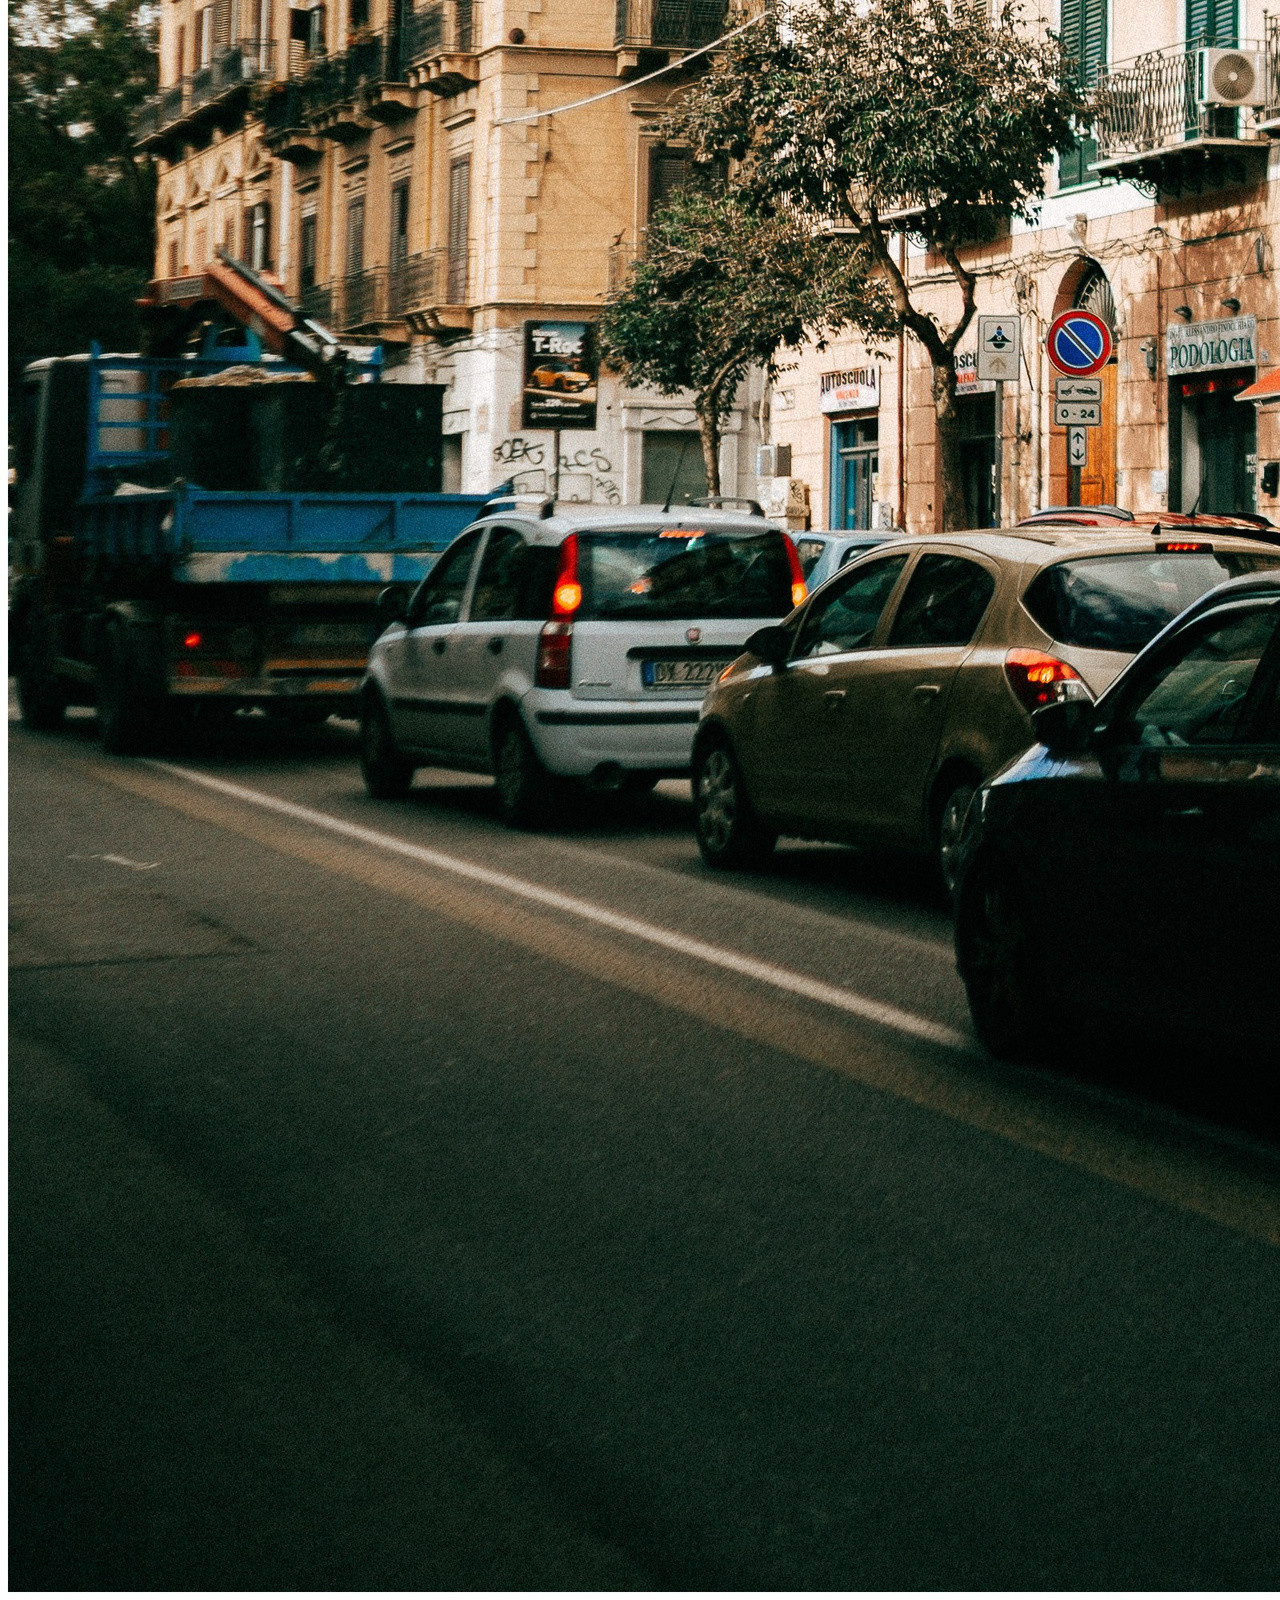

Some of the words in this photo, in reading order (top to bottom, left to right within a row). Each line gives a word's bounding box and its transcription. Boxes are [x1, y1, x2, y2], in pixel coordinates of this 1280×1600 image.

[532, 337, 583, 354] T-Roc
[1170, 337, 1255, 369] PODOLOGIA
[820, 368, 876, 397] AUTOSCUOLA
[1061, 409, 1069, 419] 0
[1080, 409, 1095, 419] 24
